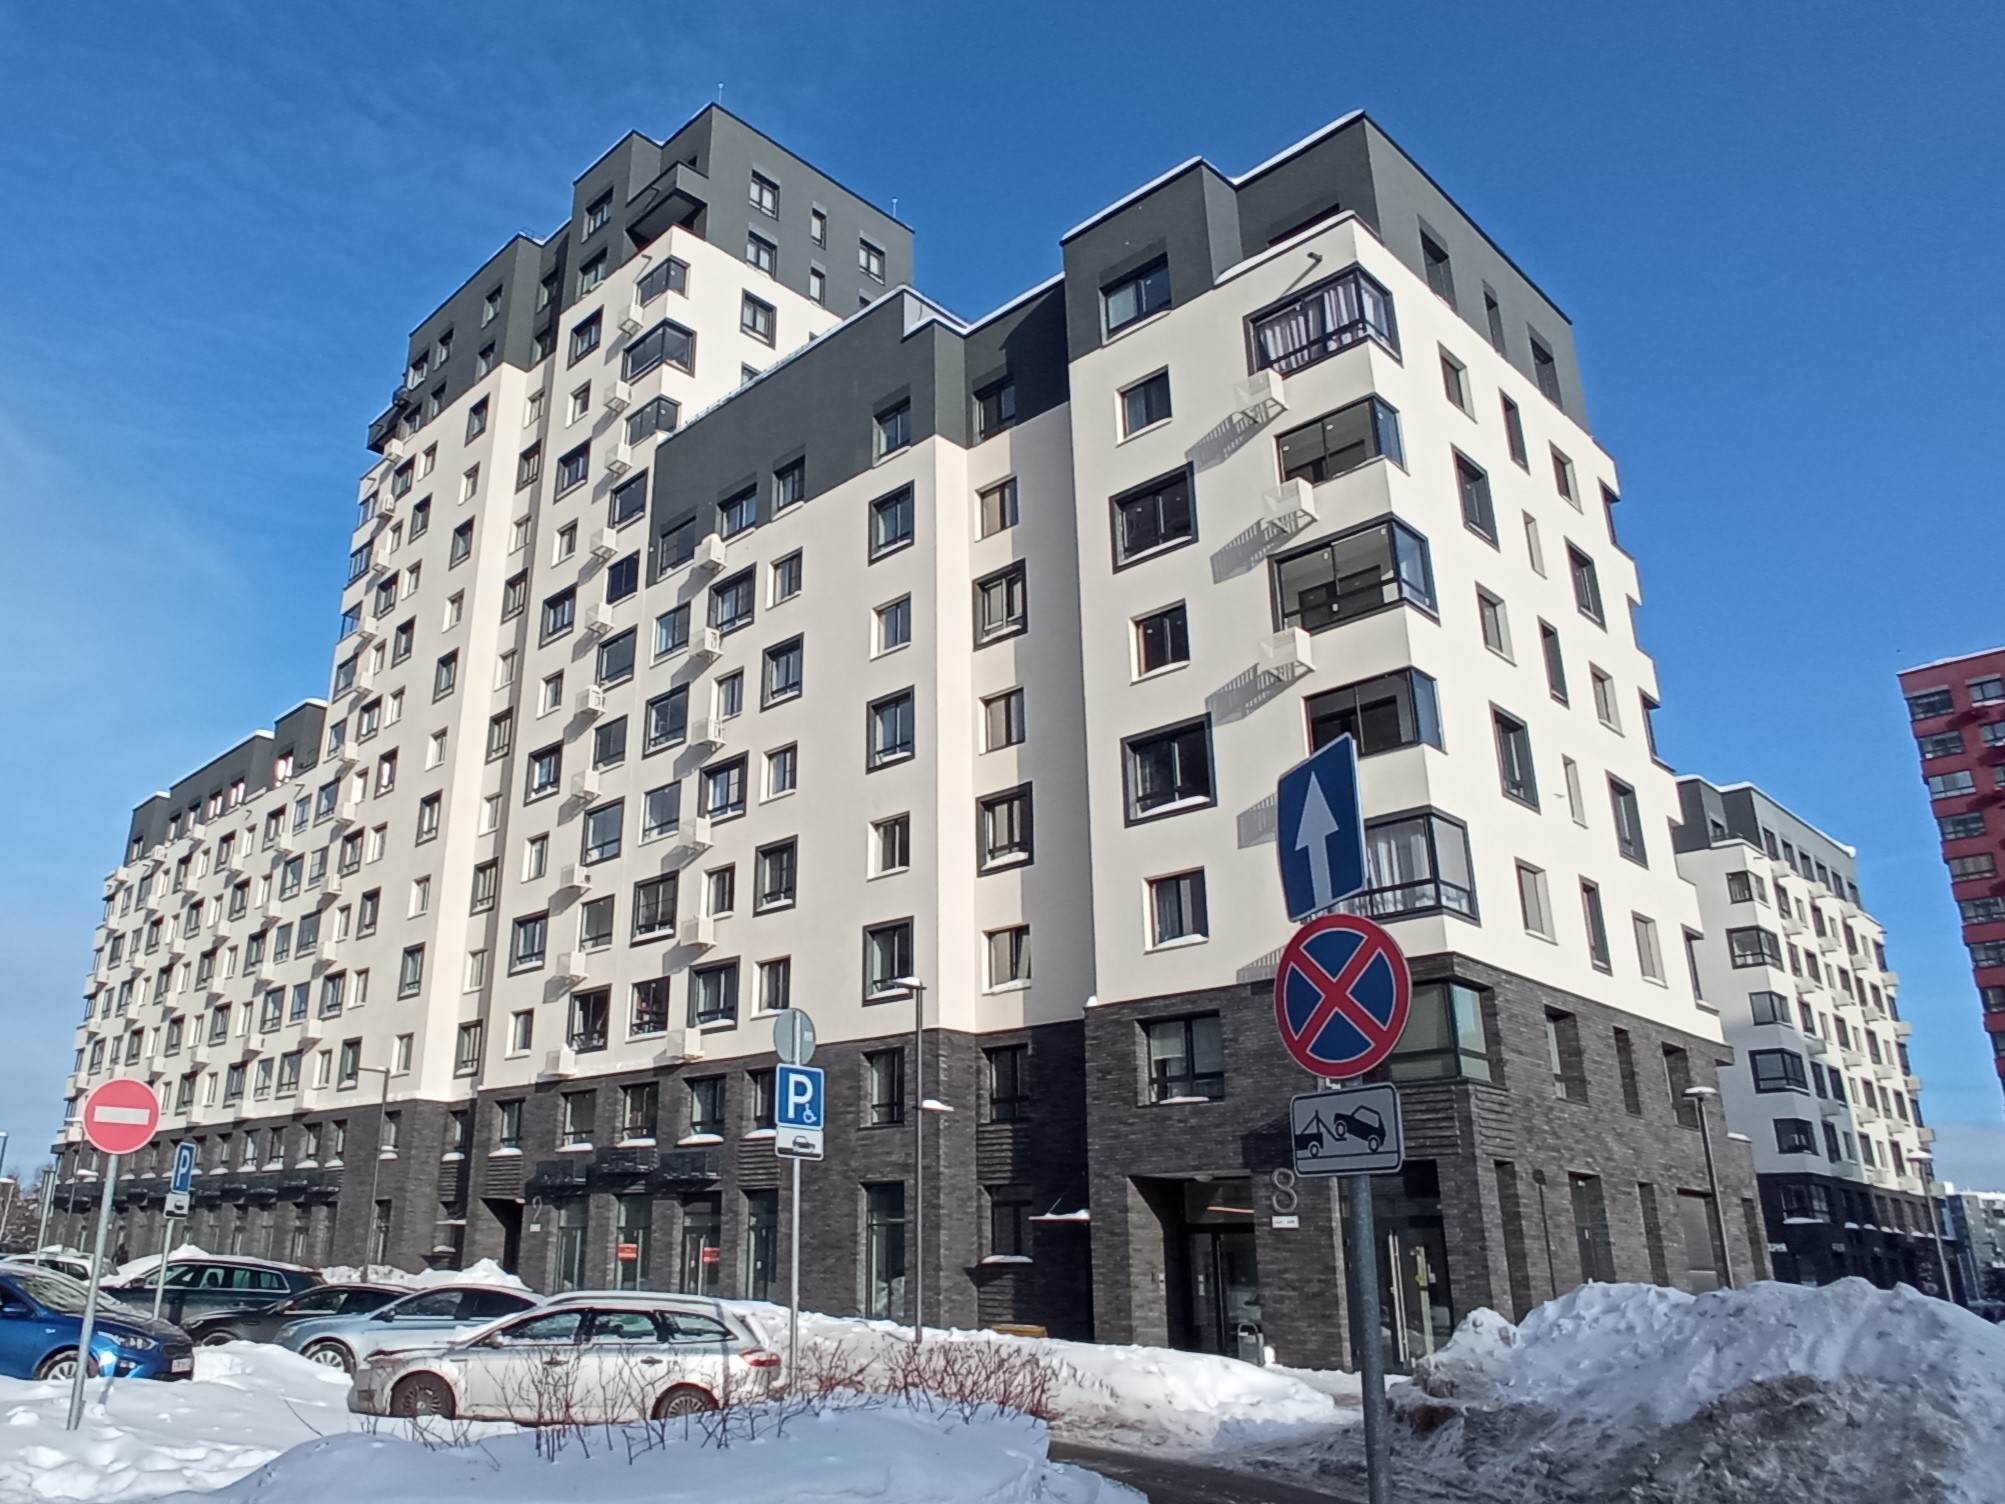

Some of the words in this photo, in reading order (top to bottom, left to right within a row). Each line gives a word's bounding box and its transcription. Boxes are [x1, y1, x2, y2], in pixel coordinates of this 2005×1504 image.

[787, 1073, 813, 1119] P
[176, 1148, 190, 1187] P
[1271, 1167, 1298, 1213] 8
